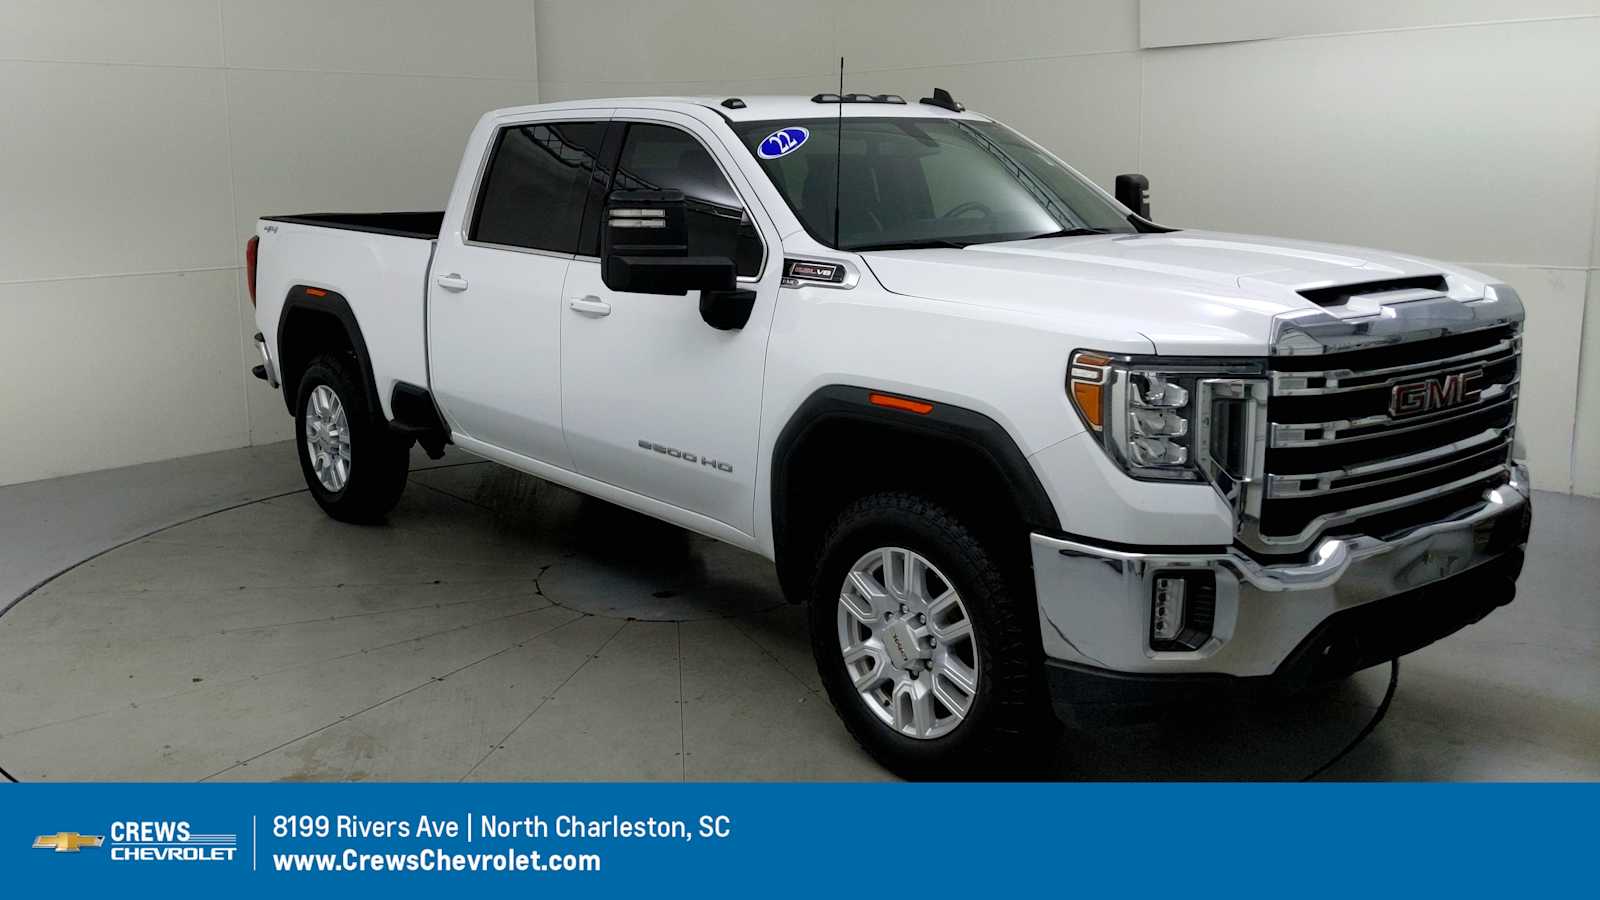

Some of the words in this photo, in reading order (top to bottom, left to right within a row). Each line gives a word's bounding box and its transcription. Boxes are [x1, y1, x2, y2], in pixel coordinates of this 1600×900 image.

[769, 131, 798, 153] 22
[1389, 368, 1484, 416] GMC
[701, 456, 733, 473] HD
